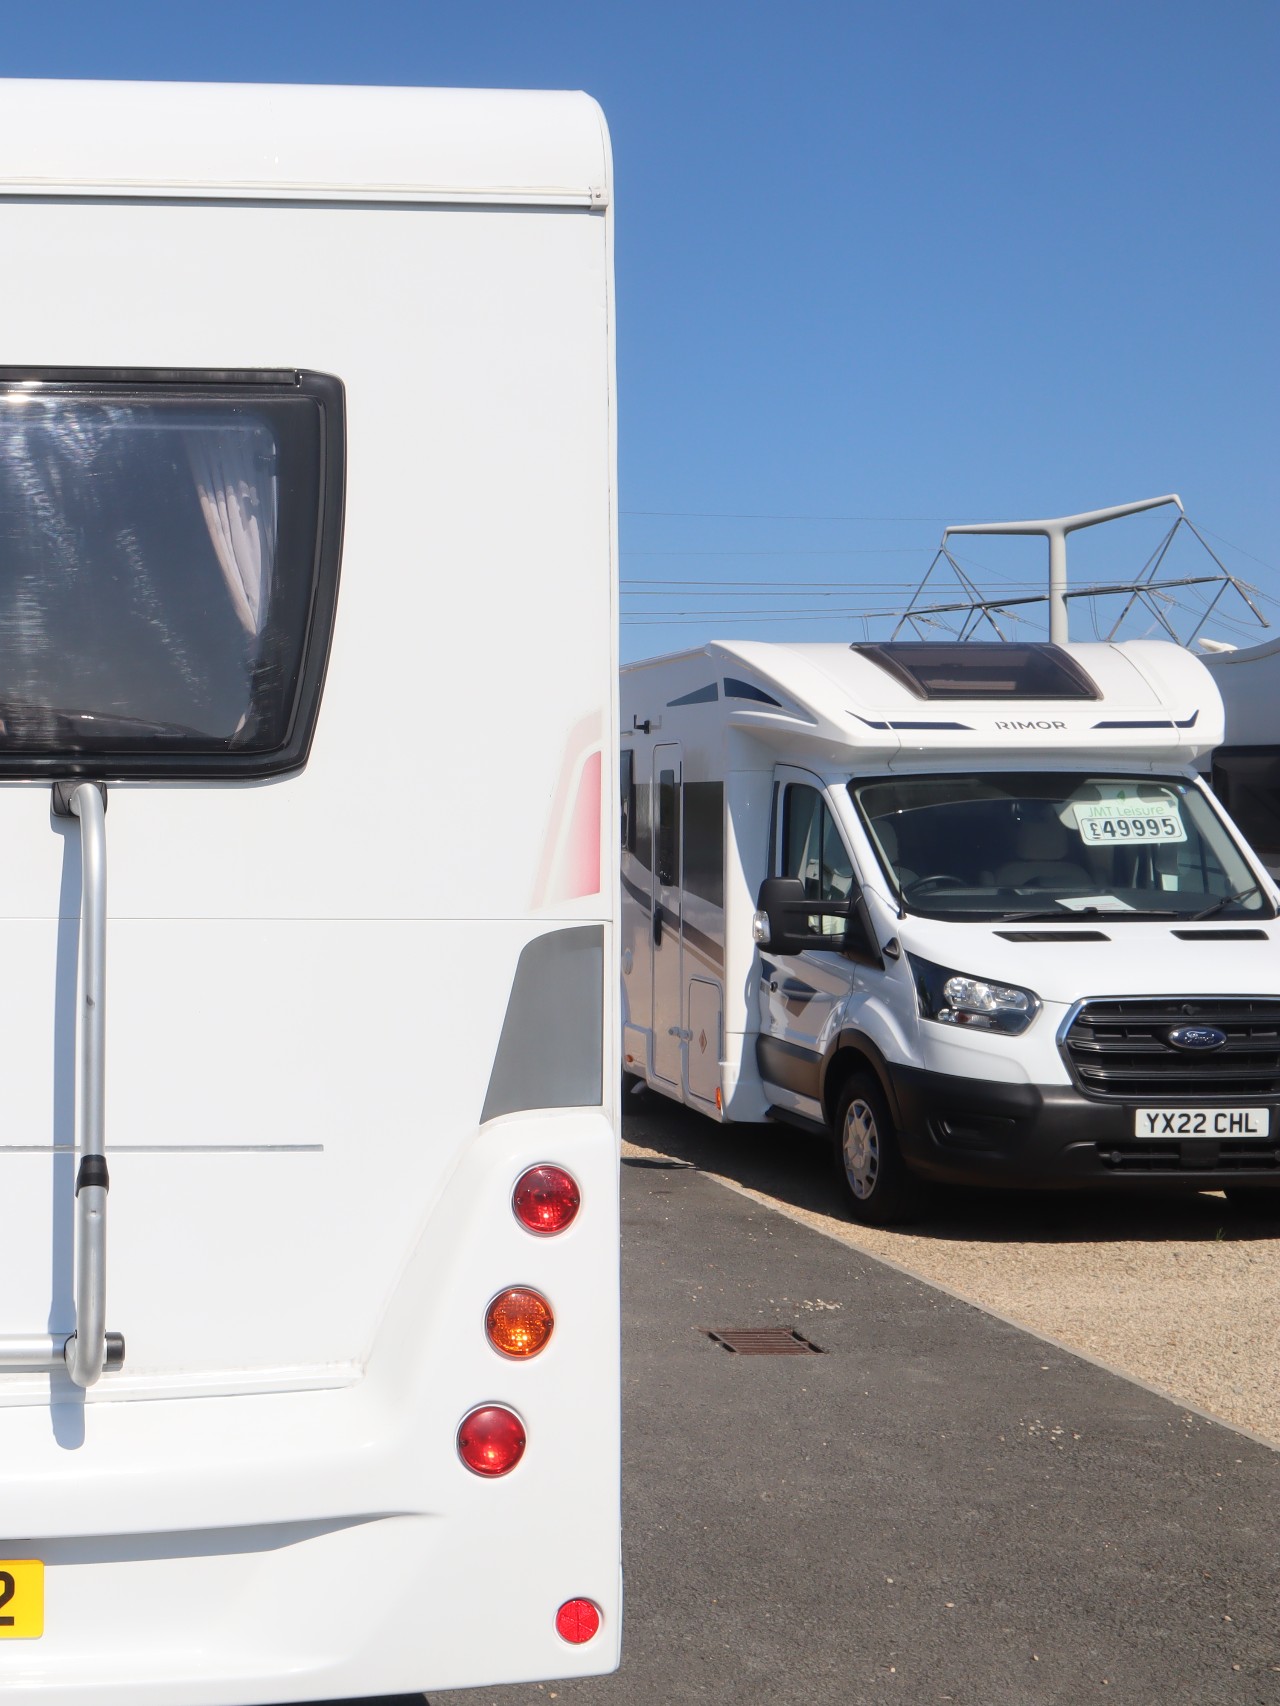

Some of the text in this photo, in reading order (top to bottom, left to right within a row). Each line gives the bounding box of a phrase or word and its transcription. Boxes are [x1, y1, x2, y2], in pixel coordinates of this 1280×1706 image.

[994, 721, 1068, 730] RIMOR
[1088, 805, 1165, 818] JMT Leisure
[1089, 818, 1176, 840] £49995
[1146, 1112, 1258, 1134] YX22 CHL
